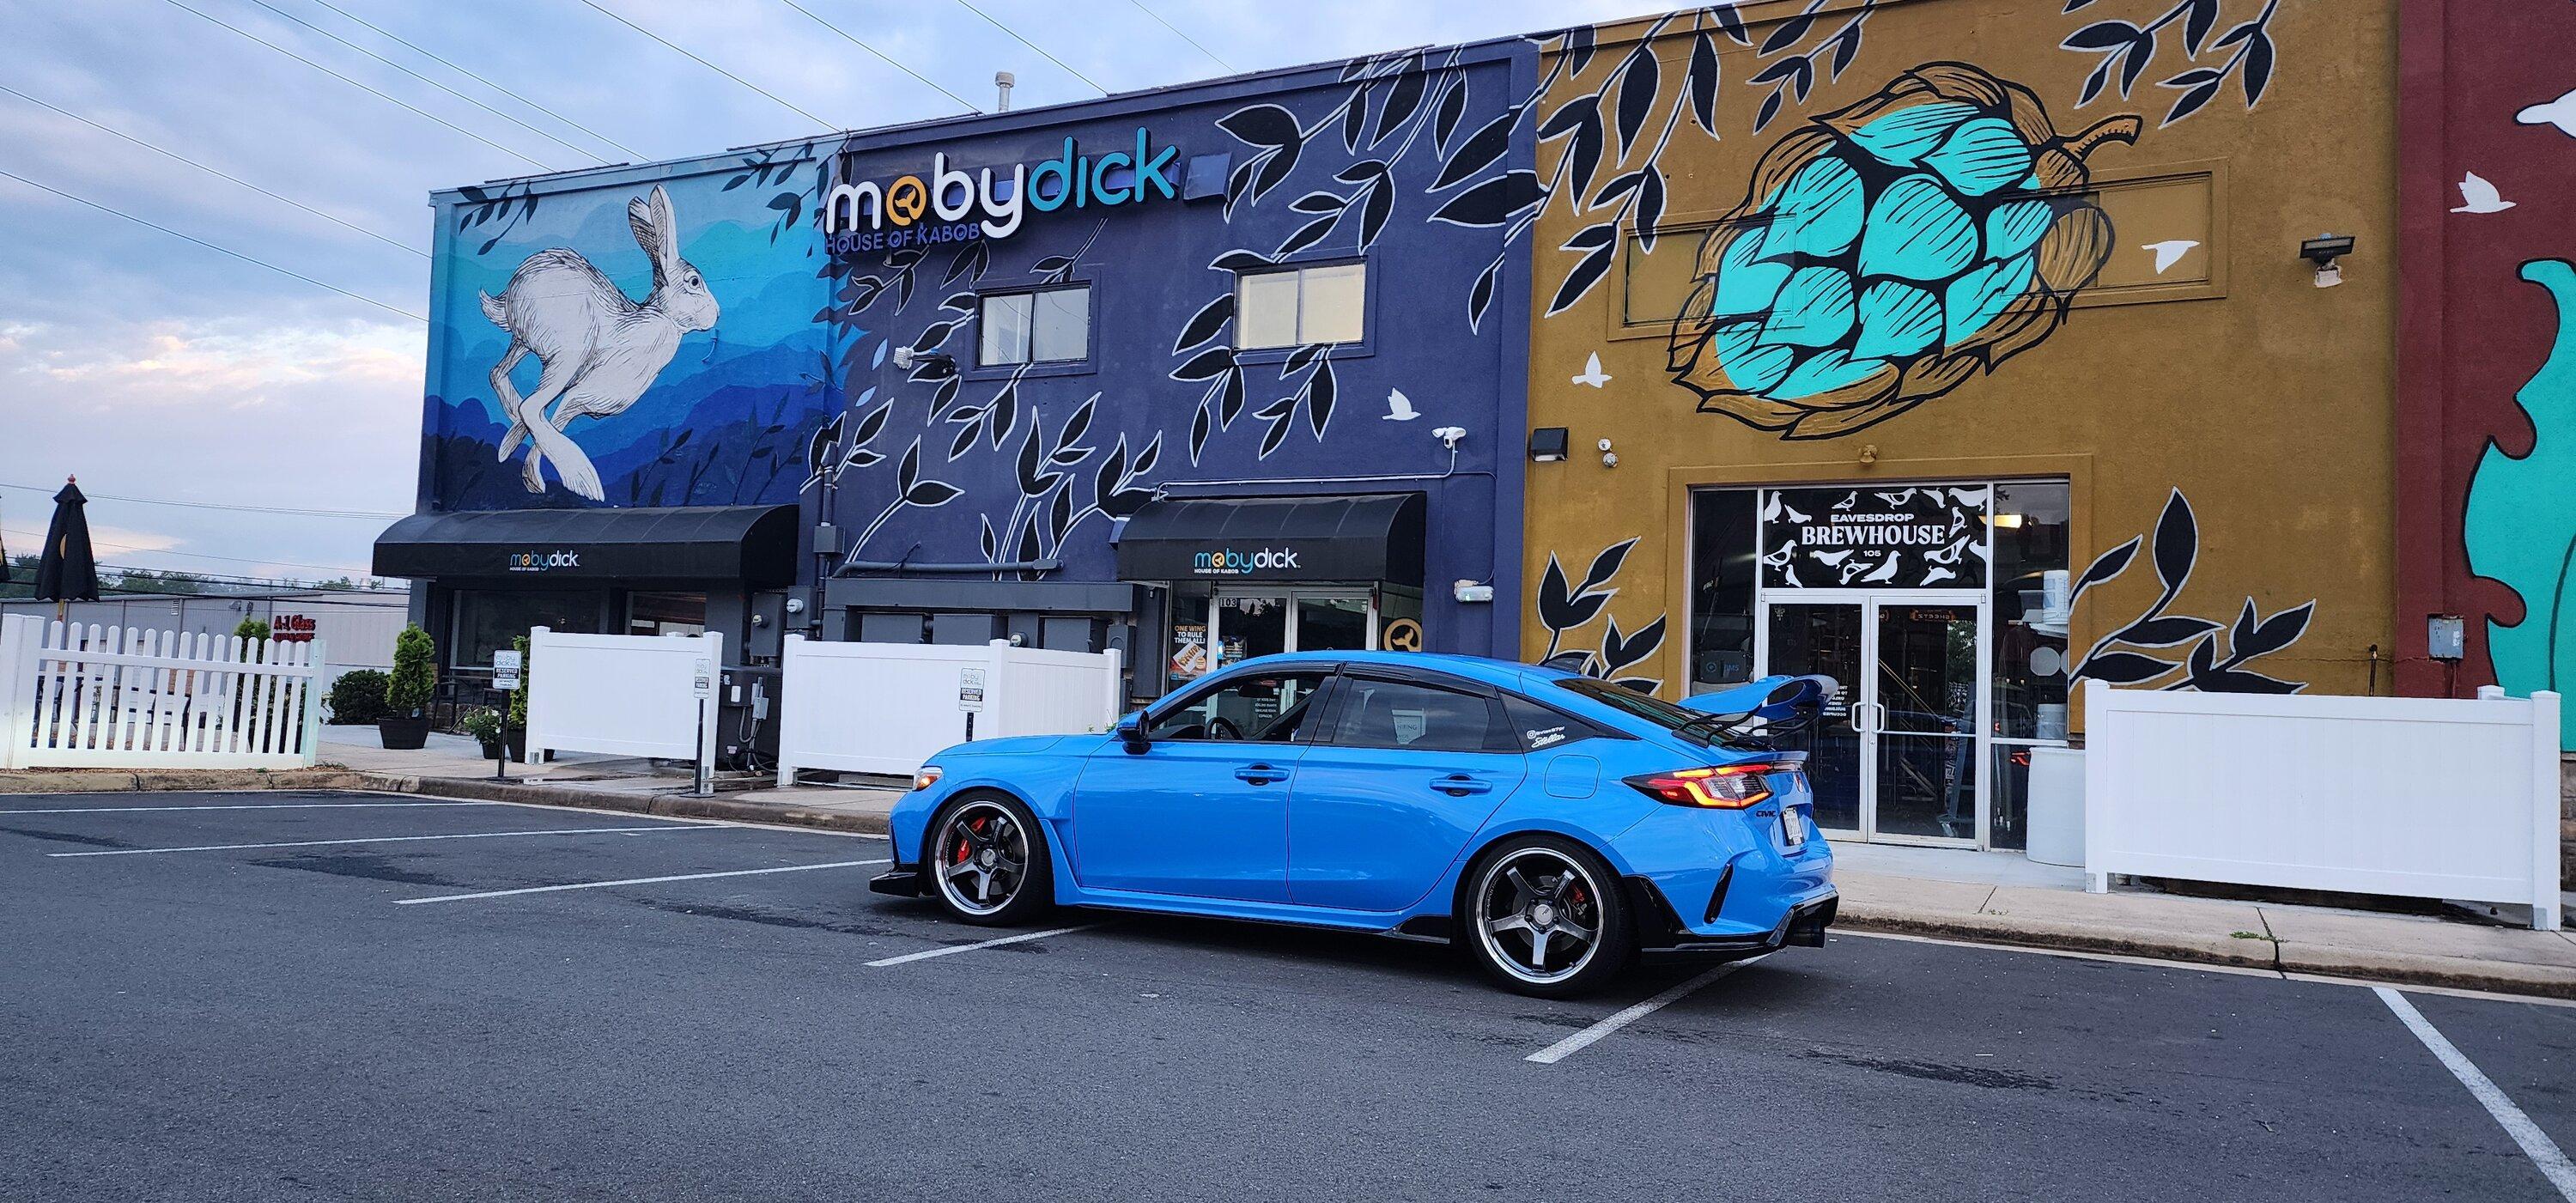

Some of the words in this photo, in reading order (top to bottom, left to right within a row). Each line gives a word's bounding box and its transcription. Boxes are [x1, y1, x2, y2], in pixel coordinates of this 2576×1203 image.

[825, 232, 884, 254] HOUSE
[888, 229, 914, 248] OF
[917, 222, 980, 246] KABOB
[1831, 513, 1915, 523] EAVESDROP
[1801, 525, 1946, 545] BREWHOUSE
[273, 615, 291, 631] A-1
[291, 614, 316, 631] Glass
